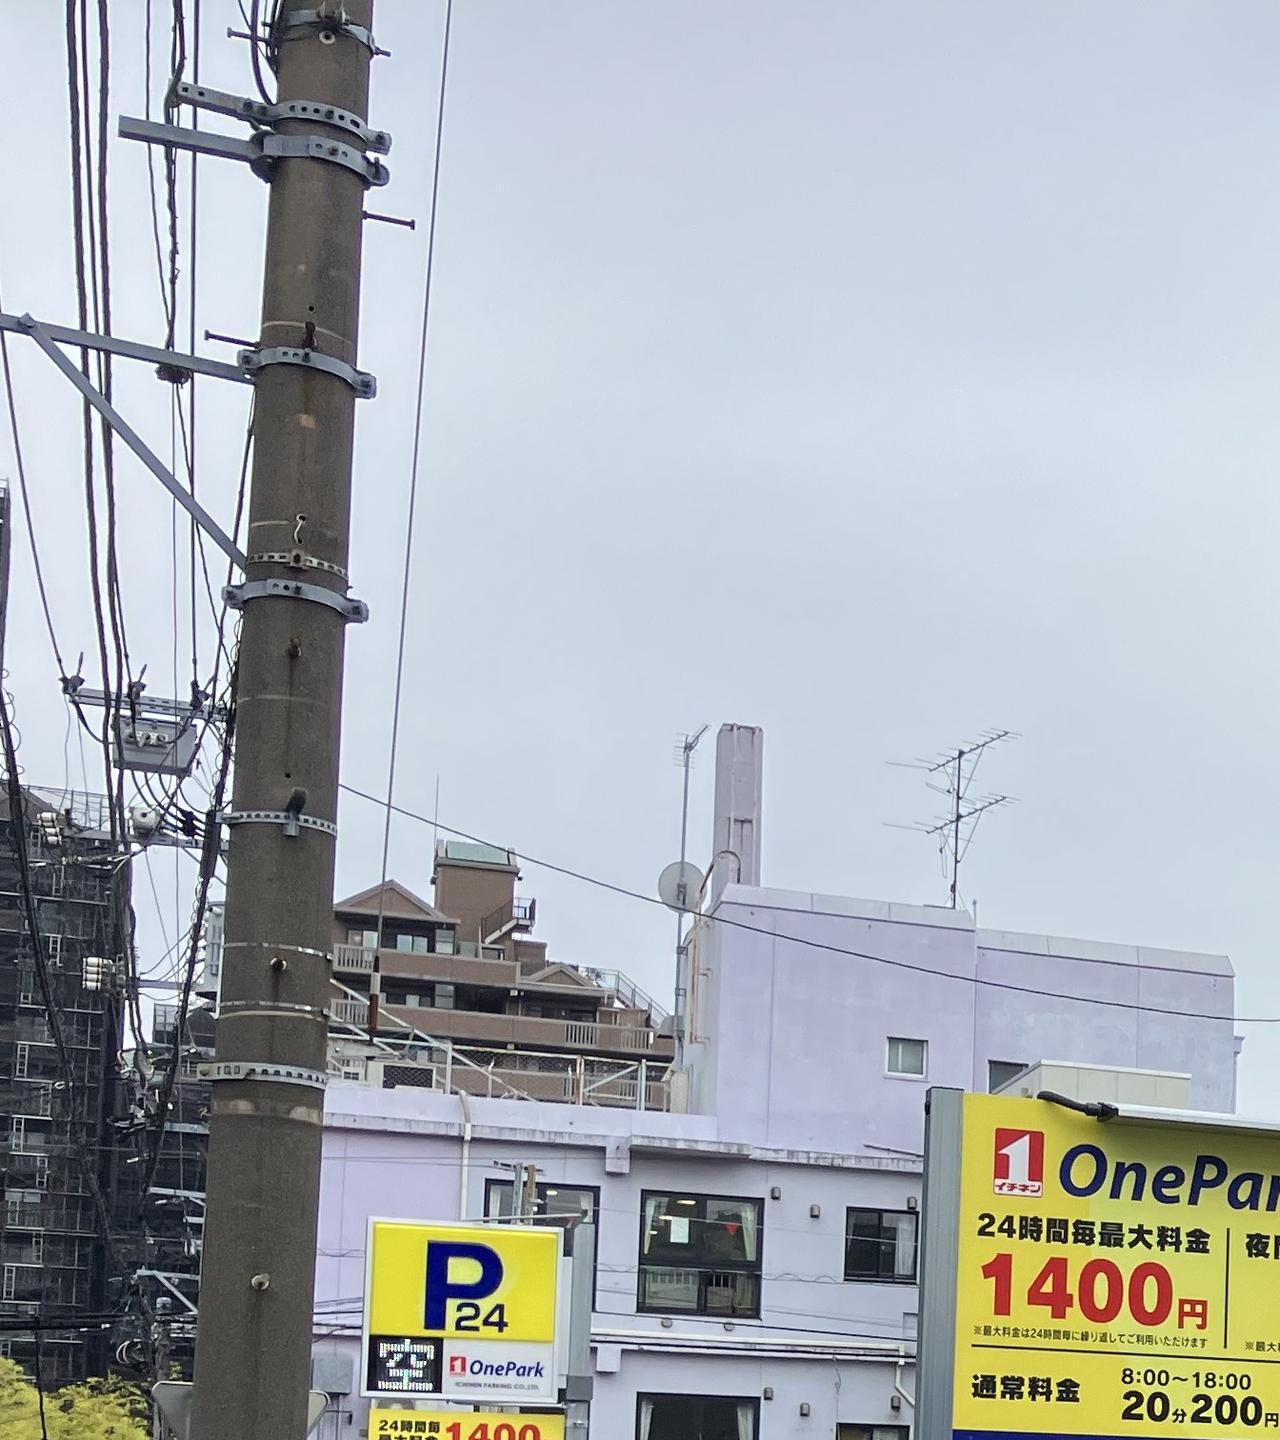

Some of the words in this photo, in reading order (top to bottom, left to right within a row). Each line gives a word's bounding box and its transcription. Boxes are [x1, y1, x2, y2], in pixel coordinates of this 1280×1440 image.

[977, 1212, 1212, 1253] 24時間毎最大料金
[424, 1240, 503, 1330] P
[981, 1253, 1208, 1329] 1400円
[455, 1302, 508, 1333] 24
[470, 1360, 544, 1377] OnePark
[972, 1373, 1080, 1403] 通常料金
[1121, 1391, 1279, 1428] 20分200円
